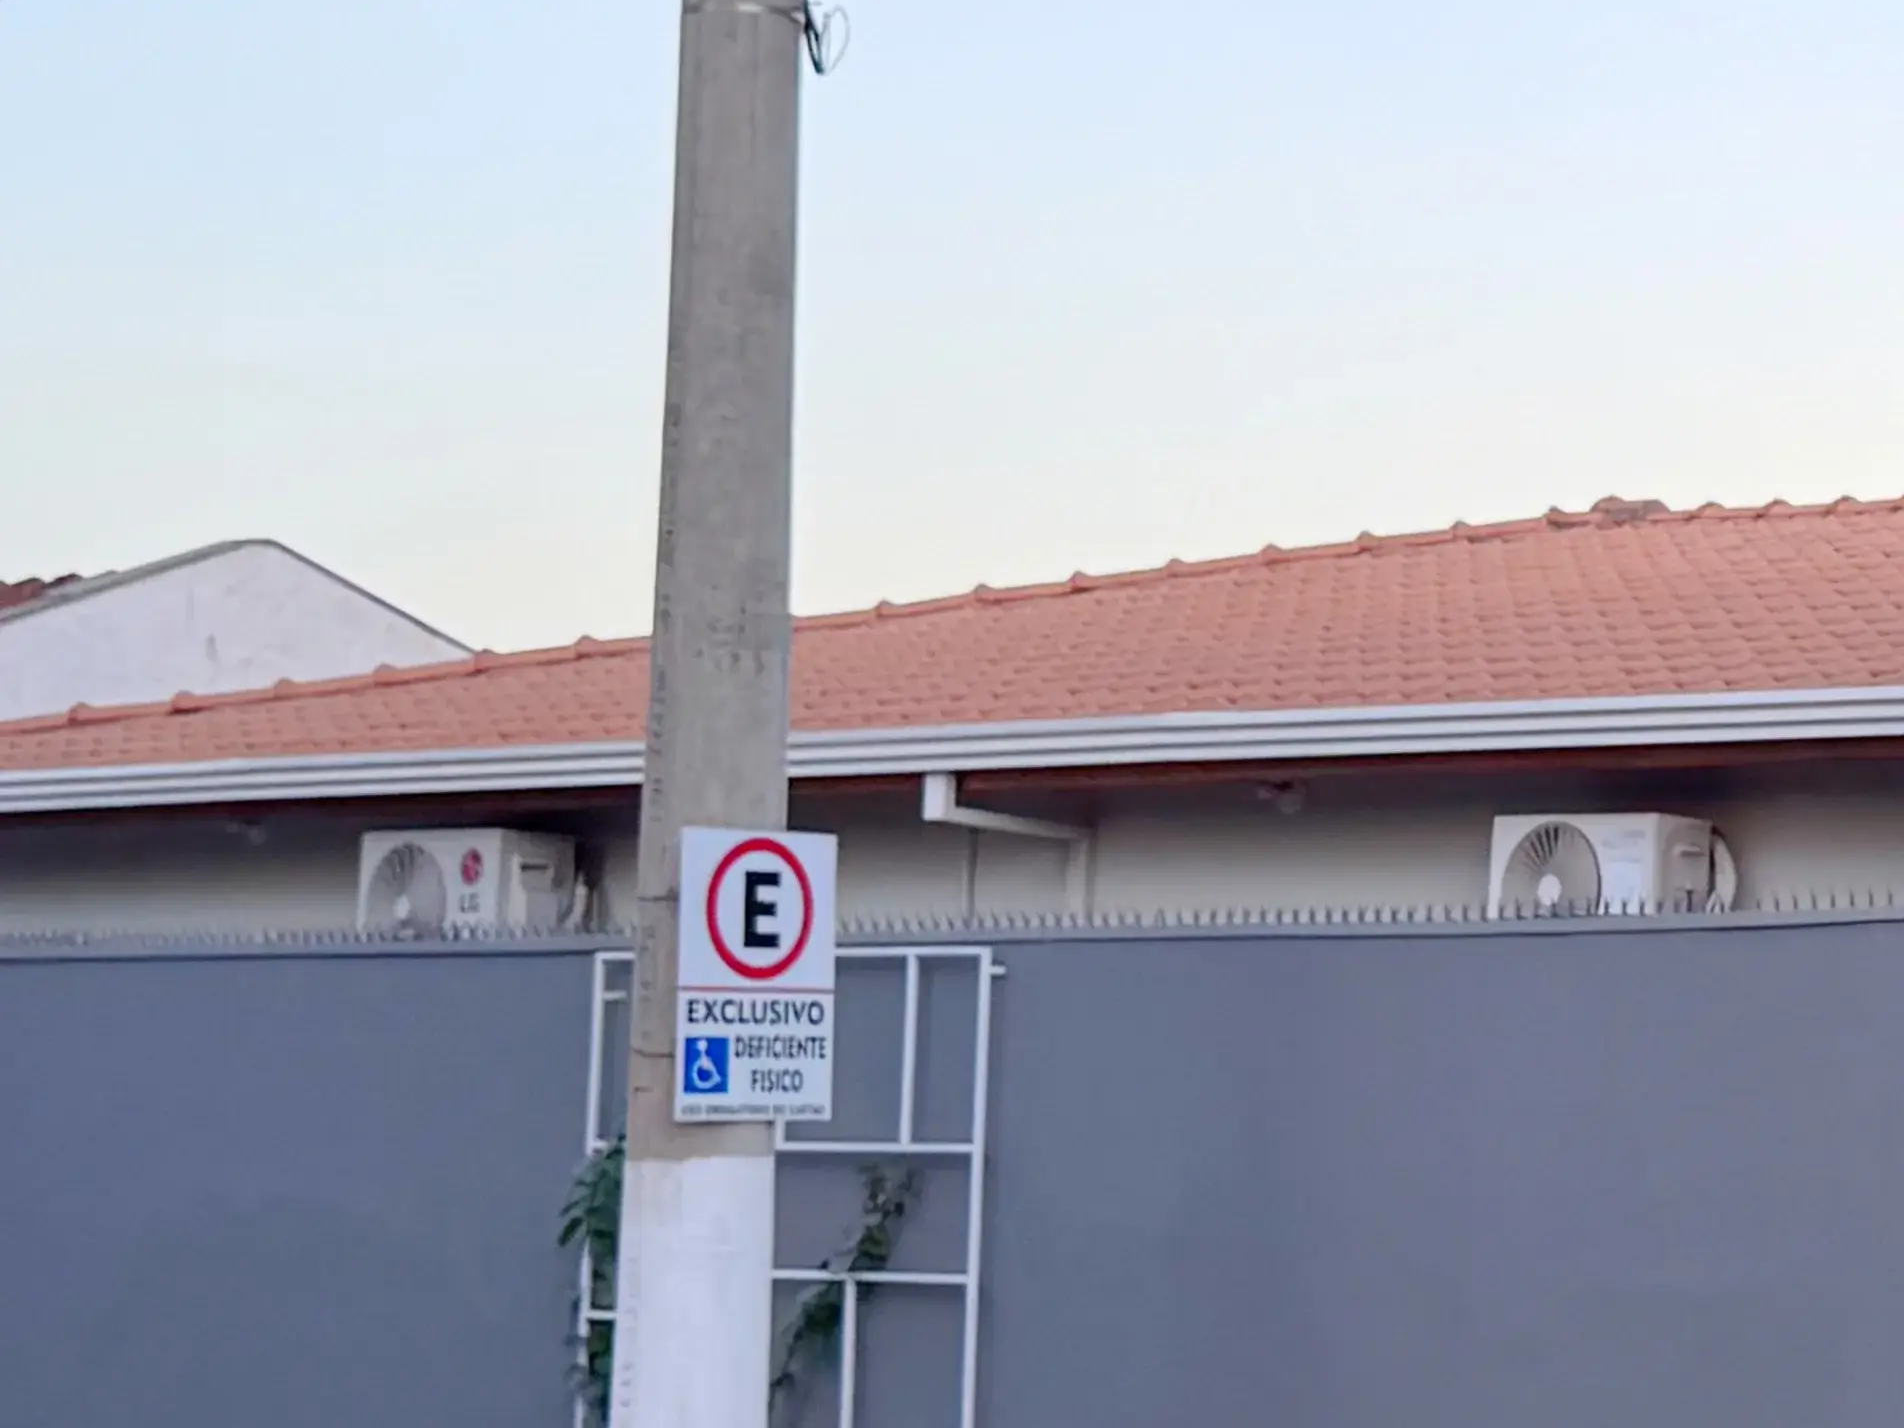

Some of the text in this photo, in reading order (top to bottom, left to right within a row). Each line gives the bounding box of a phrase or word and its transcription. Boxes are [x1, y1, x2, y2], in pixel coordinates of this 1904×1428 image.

[743, 870, 782, 948] E
[687, 998, 825, 1026] EXCLUSIVO
[734, 1035, 827, 1060] DEFICIENTE
